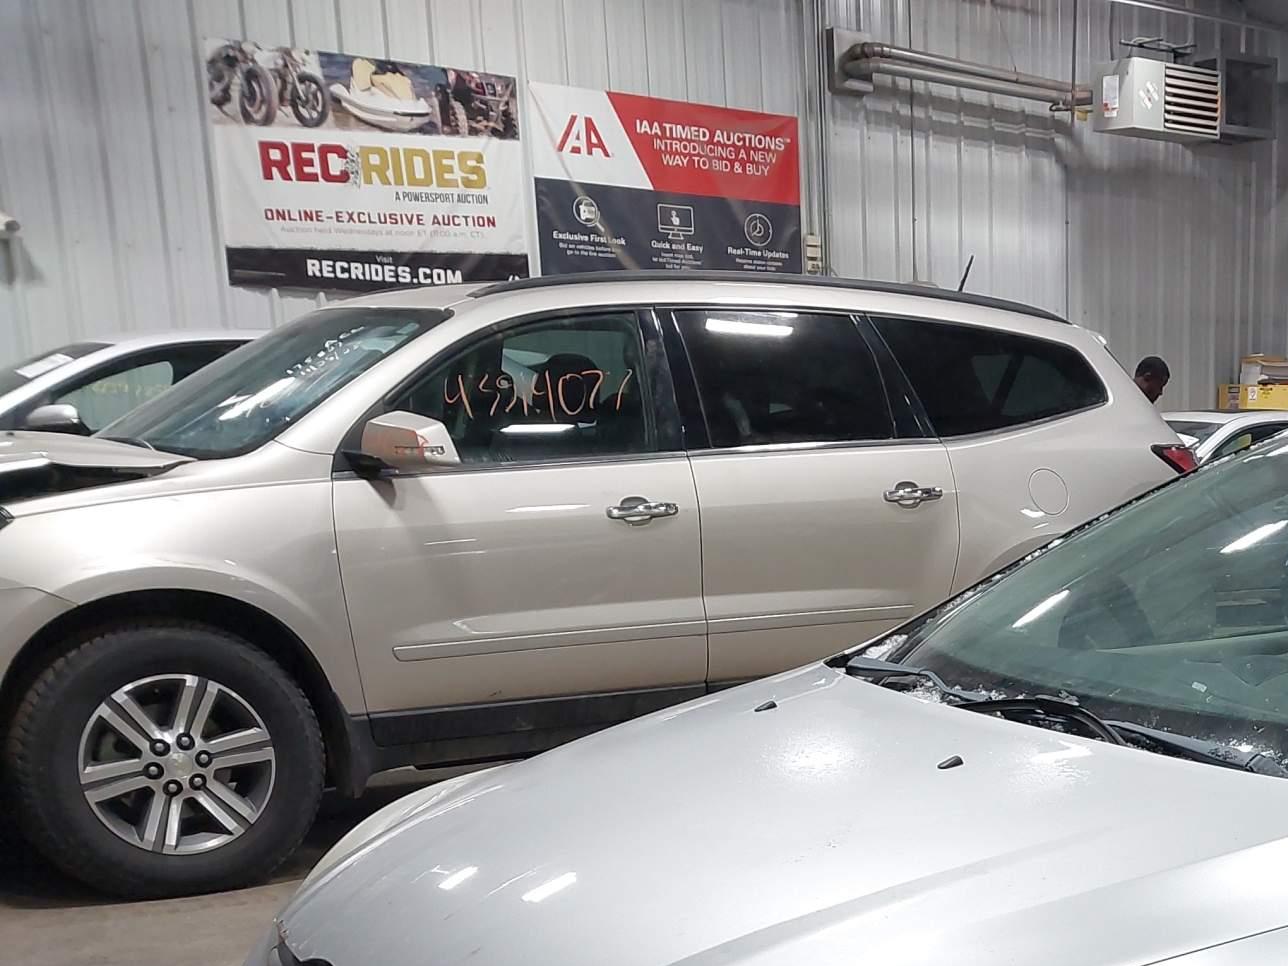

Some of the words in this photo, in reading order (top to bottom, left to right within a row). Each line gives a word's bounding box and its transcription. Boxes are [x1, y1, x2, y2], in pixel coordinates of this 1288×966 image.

[635, 119, 662, 138] IAA
[662, 122, 709, 141] TIMED
[652, 138, 736, 160] INTRODUCING
[738, 150, 747, 161] A
[749, 150, 777, 164] NEW
[358, 144, 489, 190] RIDES
[661, 153, 689, 168] WAY
[692, 156, 709, 170] TO
[711, 160, 731, 173] BID
[733, 162, 743, 174] &
[745, 163, 770, 177] BUY
[394, 191, 401, 201] A
[401, 191, 455, 204] POWERSPORT
[456, 193, 489, 206] AUCTION
[263, 207, 426, 226] ONLINE-EXCLUSIVE
[430, 213, 497, 228] AUCTION
[552, 230, 589, 242] Exclusive
[590, 234, 607, 244] First
[651, 240, 670, 250] Quick
[671, 241, 685, 251] and
[686, 242, 704, 254] Easy
[375, 254, 393, 264] Visit
[727, 246, 761, 257] Real-Time
[762, 249, 789, 260] Updates
[306, 258, 464, 285] RECRIDES.COM
